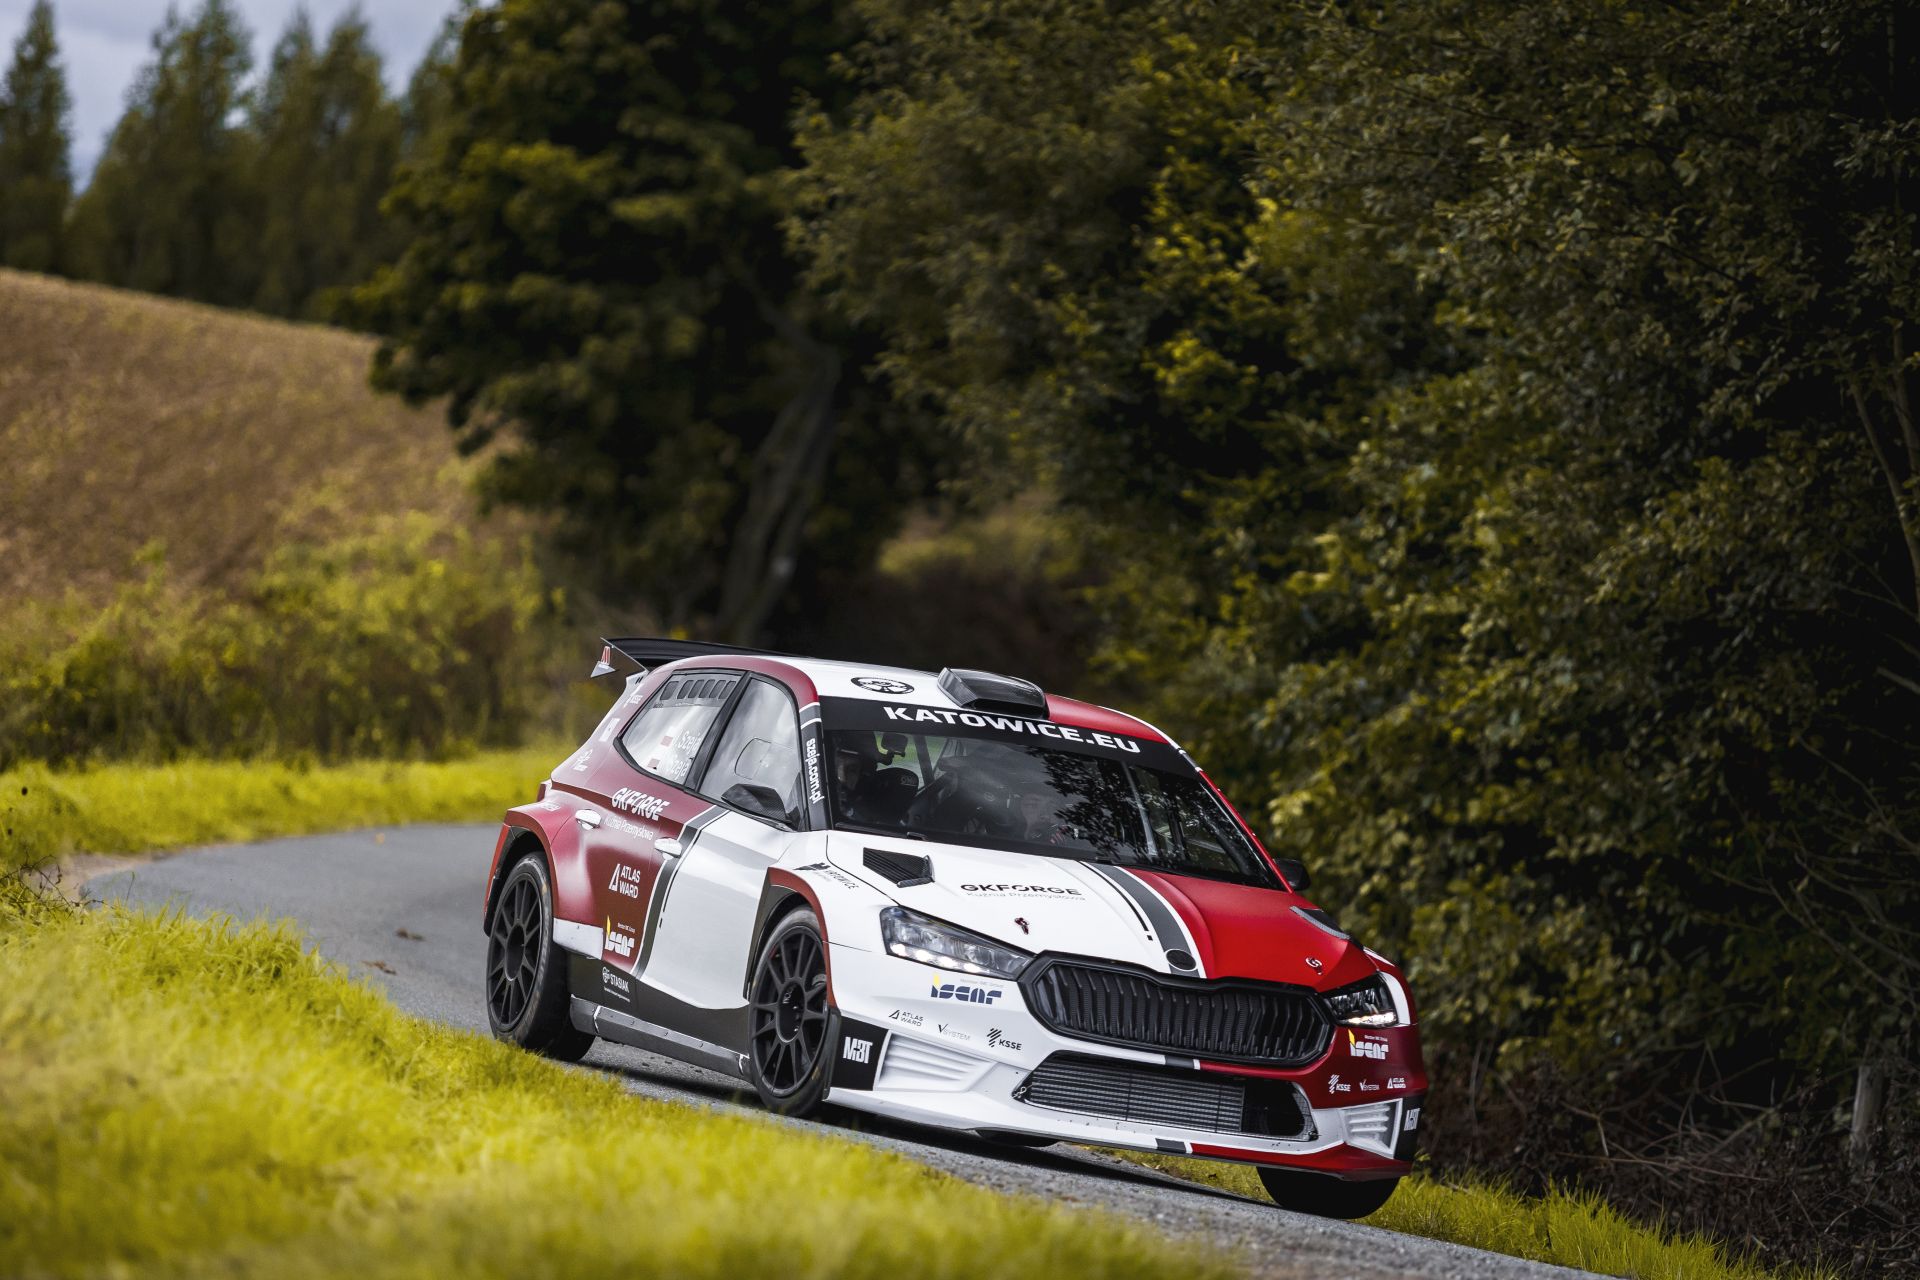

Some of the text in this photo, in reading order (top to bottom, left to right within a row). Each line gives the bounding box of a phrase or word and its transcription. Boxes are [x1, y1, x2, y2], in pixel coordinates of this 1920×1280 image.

[882, 705, 1141, 754] KATOWICE.EU
[805, 738, 825, 805] szeja.com.pl
[611, 787, 670, 821] GKFORGE
[620, 865, 641, 883] ATLAS
[619, 880, 639, 899] WARD
[960, 884, 1083, 897] GKFORGE
[900, 1016, 922, 1027] WARD
[901, 1011, 924, 1022] ATLAS
[998, 1038, 1022, 1051] KSSE
[1335, 1083, 1352, 1092] KSSE
